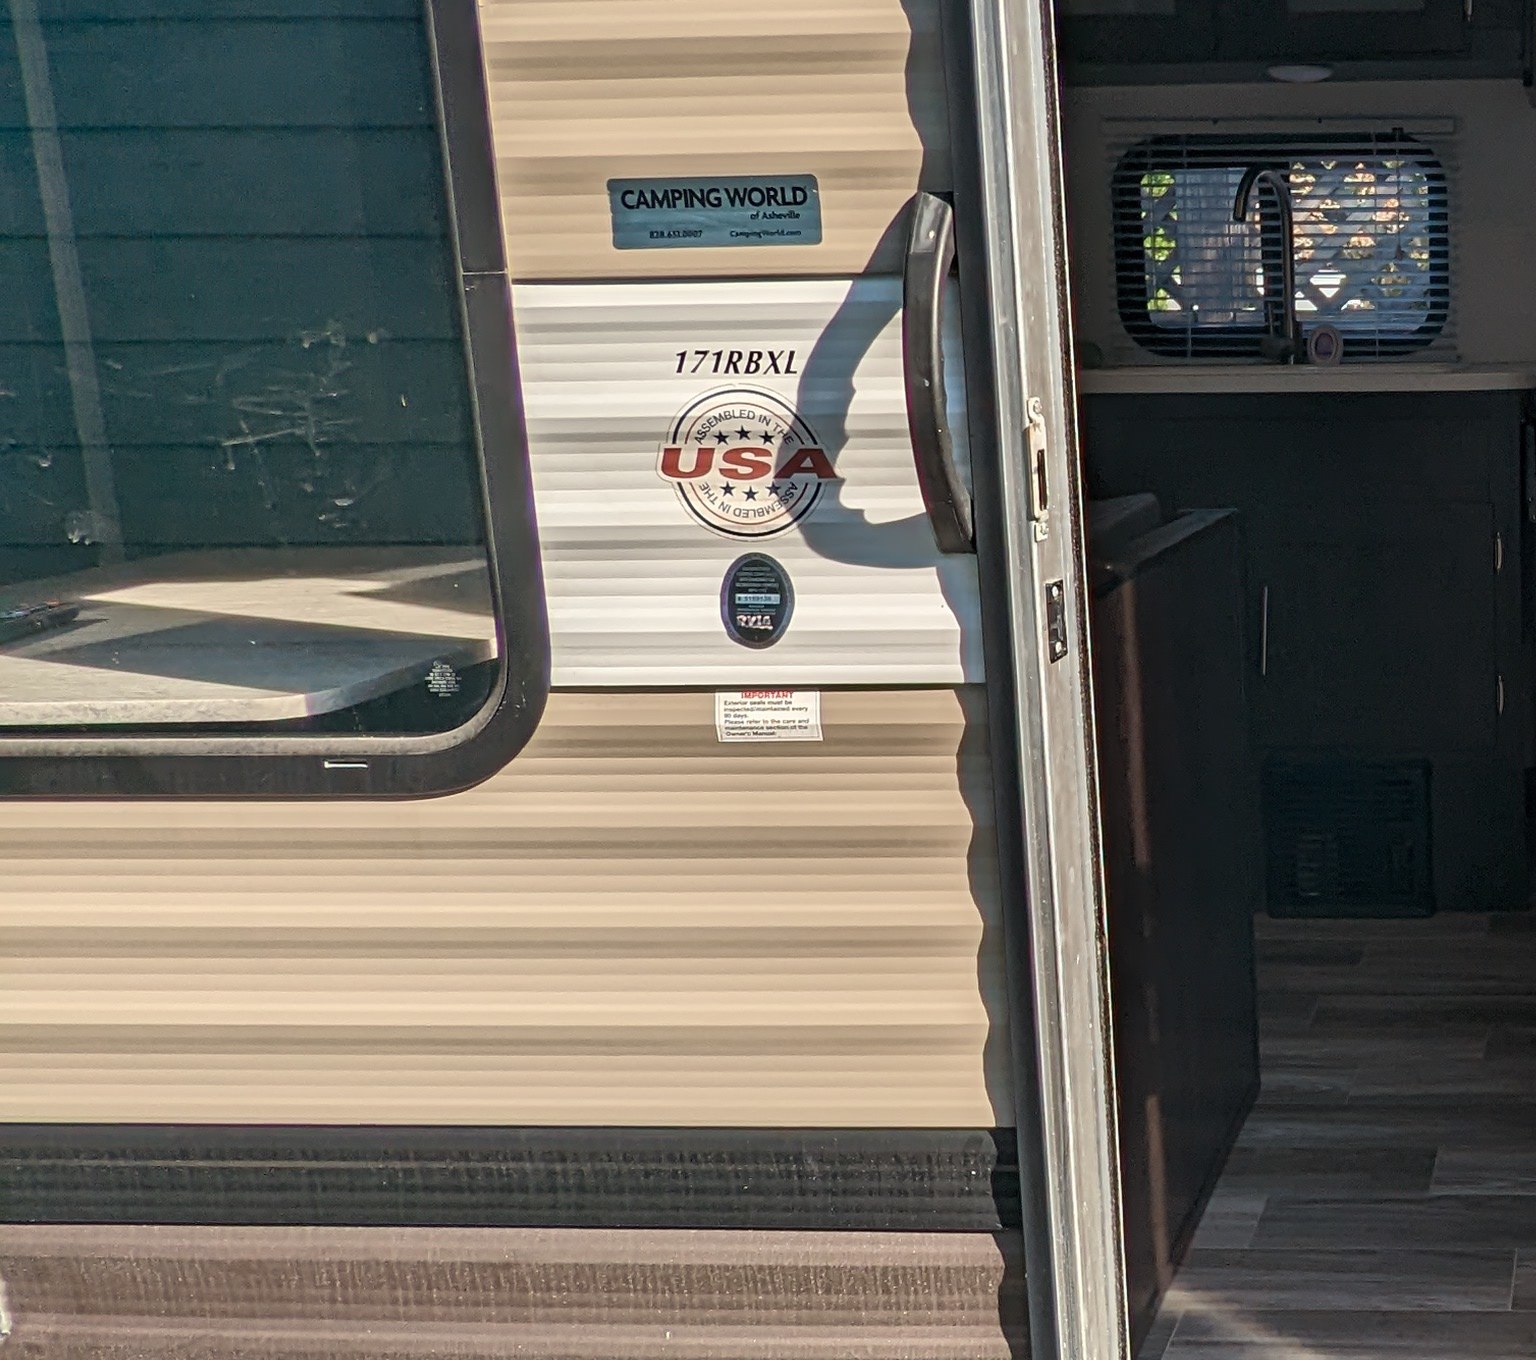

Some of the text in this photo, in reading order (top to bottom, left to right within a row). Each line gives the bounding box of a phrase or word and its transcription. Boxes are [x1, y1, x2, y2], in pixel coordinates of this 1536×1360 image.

[621, 186, 807, 210] CAMPING WORLD
[750, 210, 800, 220] of Asheville
[676, 350, 797, 375] 171RBXL
[694, 409, 794, 444] ASSEMBLED IN THE
[661, 447, 837, 480] USA
[699, 481, 798, 518] ASSEMBLED IN THE
